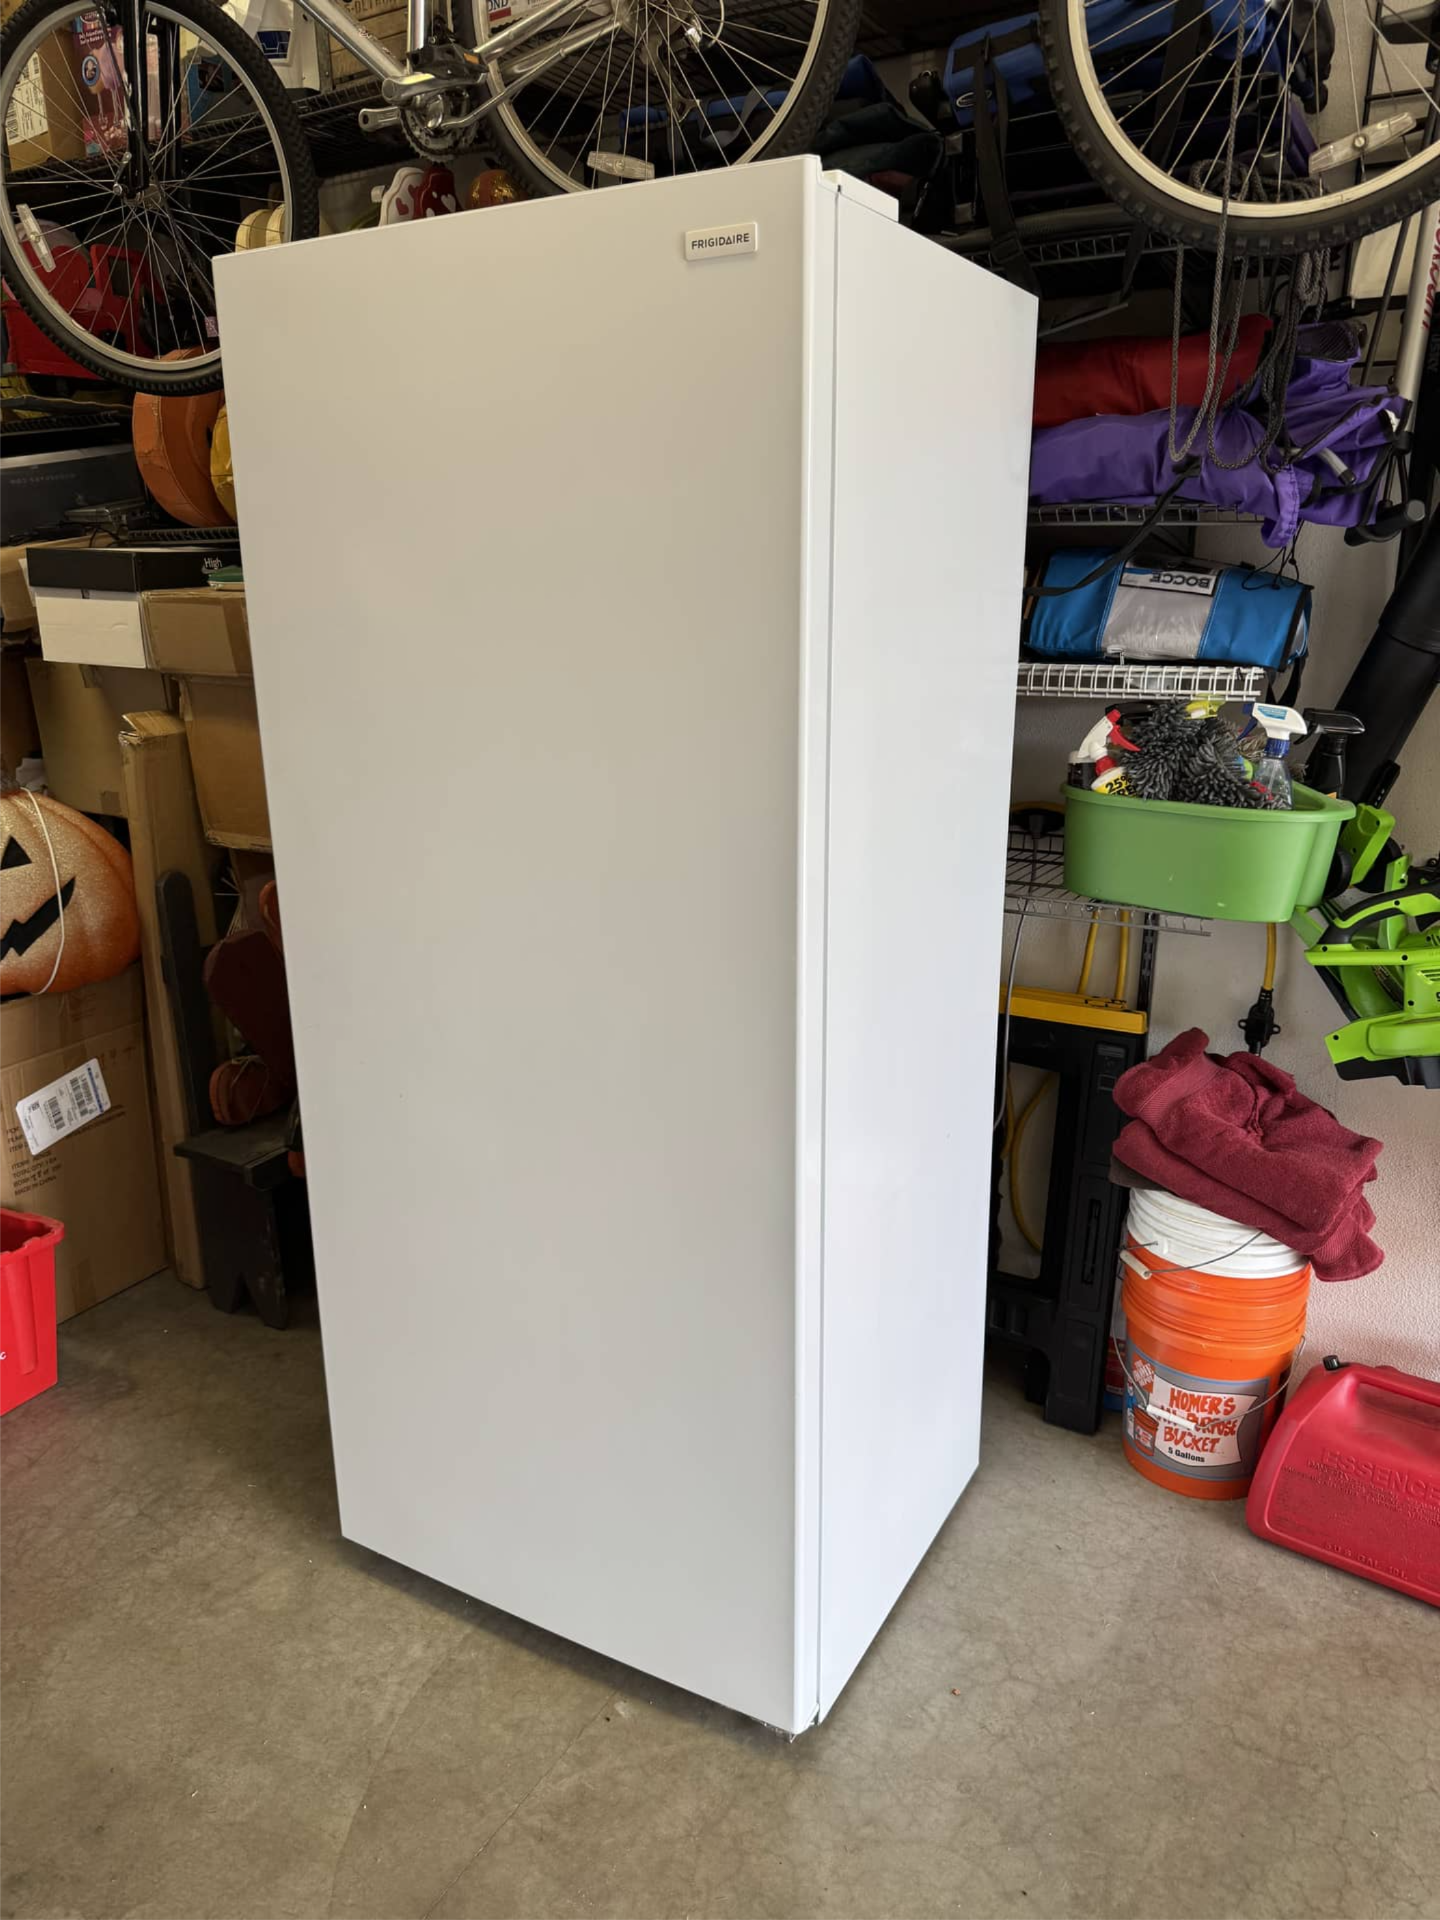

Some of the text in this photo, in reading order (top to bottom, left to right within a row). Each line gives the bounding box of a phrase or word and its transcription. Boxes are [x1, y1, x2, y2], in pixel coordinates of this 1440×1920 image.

[691, 232, 751, 250] FRIGIDAIRE
[1149, 571, 1213, 589] BOCCE
[1105, 774, 1133, 793] 25%
[1169, 1387, 1237, 1416] HOMER'S
[1164, 1425, 1221, 1453] BUCKET
[1168, 1446, 1206, 1463] 5 Gallons
[1321, 1449, 1440, 1503] ESSENCE
